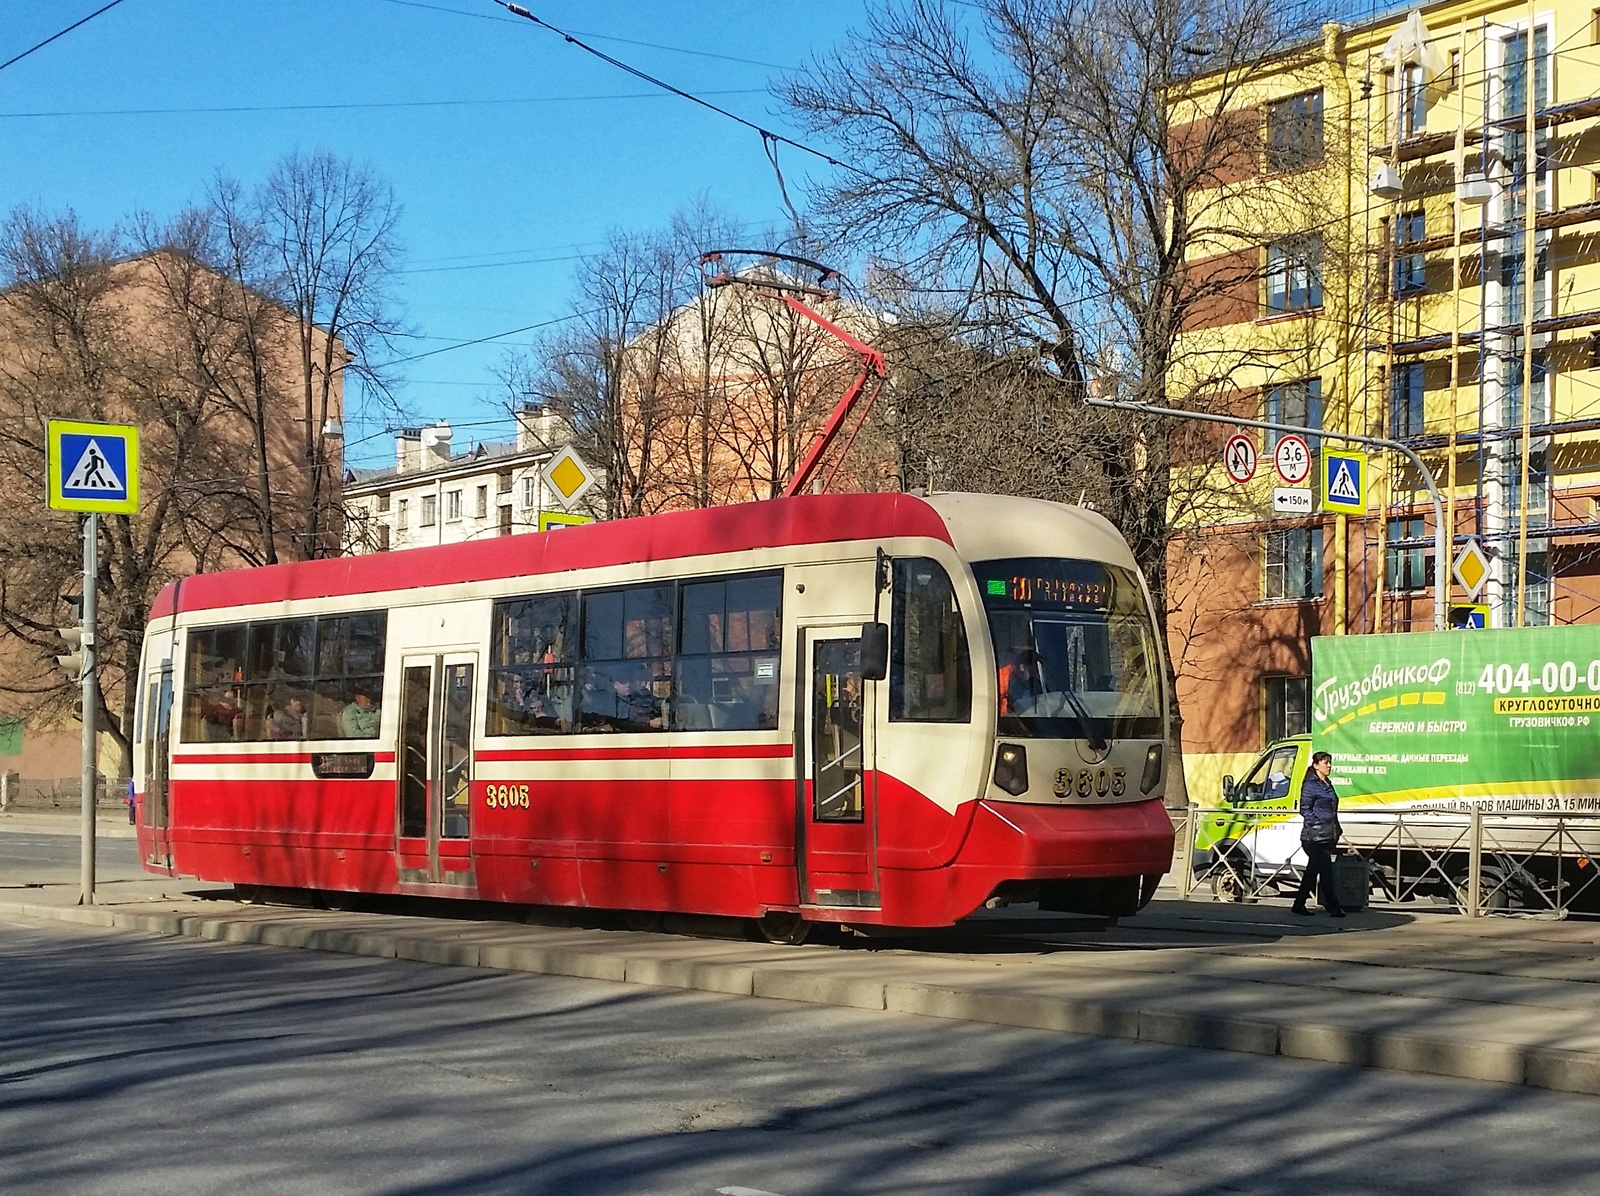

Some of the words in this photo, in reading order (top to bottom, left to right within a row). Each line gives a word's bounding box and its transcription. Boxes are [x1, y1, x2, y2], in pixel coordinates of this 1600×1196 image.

[1283, 446, 1302, 462] 3,6
[1288, 496, 1302, 505] 150
[1455, 681, 1476, 696] (812)
[1499, 697, 1600, 712] КРУГЛОСУТОЧНО
[1369, 721, 1415, 733] БЕРЕЖНО
[1416, 721, 1425, 732] И
[1426, 720, 1468, 732] БЫСТРО
[1509, 715, 1590, 728] ГРУЗОВИЧКОФ.РФ
[1400, 753, 1430, 763] ДАЧНЫЕ
[1431, 753, 1469, 763] ПЕРЕЕЗДЫ
[1052, 767, 1126, 798] 3605
[486, 784, 530, 809] 3605
[1496, 798, 1545, 811] МАШИНЫ
[1547, 798, 1560, 810] ЗА
[1564, 798, 1576, 810] 15
